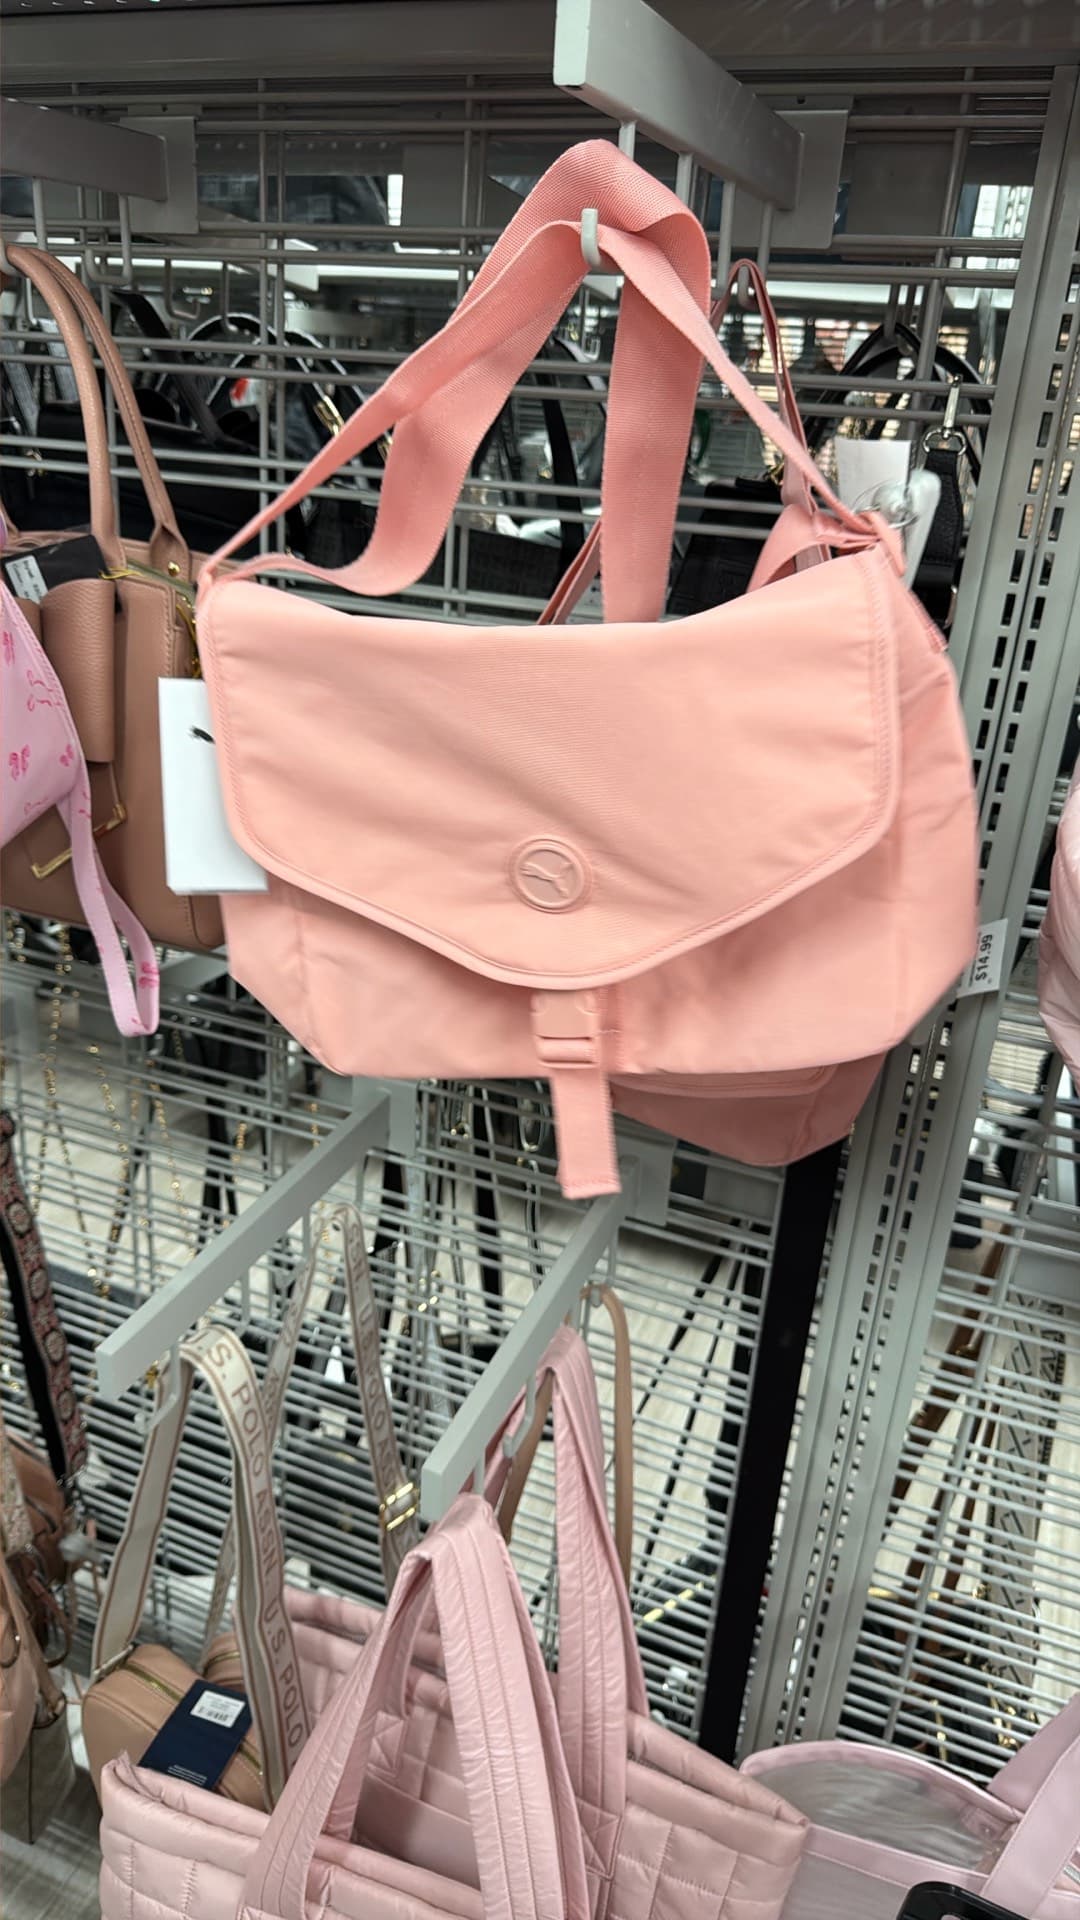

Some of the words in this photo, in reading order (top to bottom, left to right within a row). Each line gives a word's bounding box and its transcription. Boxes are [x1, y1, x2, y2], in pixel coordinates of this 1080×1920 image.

[974, 934, 993, 981] $14.99
[231, 1381, 266, 1477] POLO
[256, 1488, 279, 1586] ASSN.
[264, 1598, 286, 1665] U.S.
[279, 1664, 304, 1748] POLO
